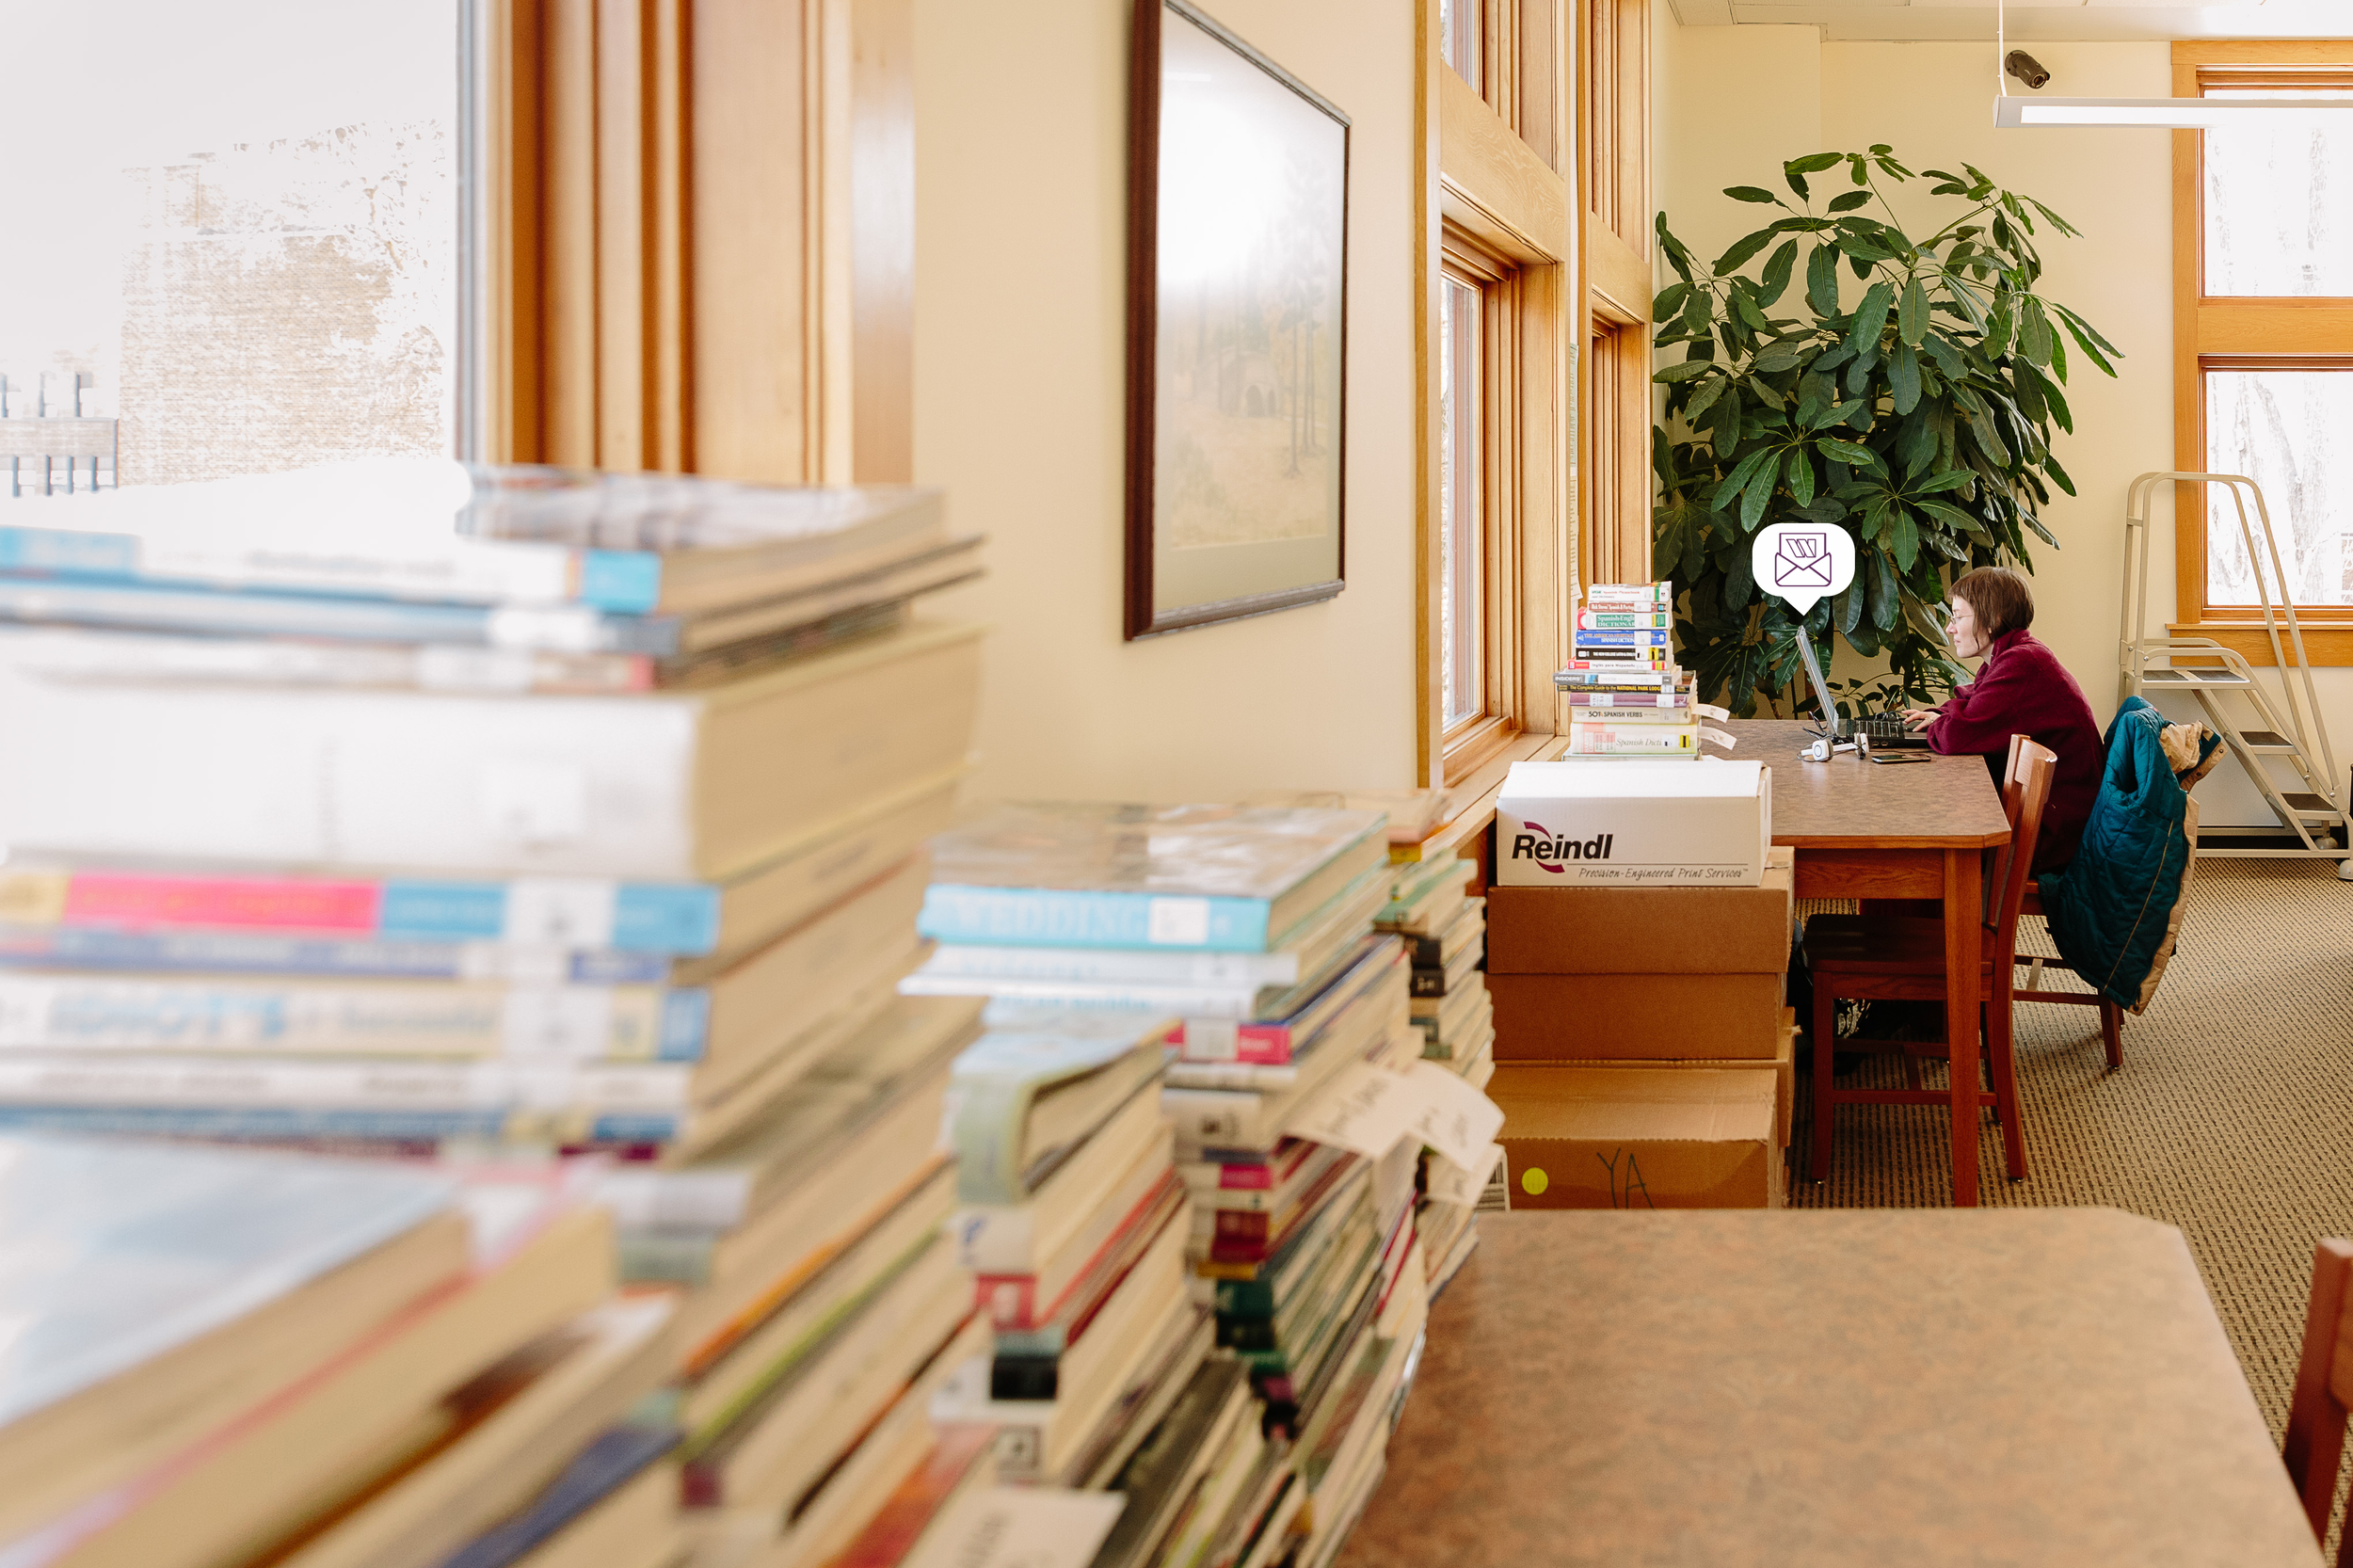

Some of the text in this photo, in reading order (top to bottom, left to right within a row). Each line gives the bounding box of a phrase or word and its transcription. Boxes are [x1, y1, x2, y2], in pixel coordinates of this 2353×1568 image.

[1616, 738, 1643, 746] Spanish
[1645, 738, 1662, 746] Dicti
[1512, 834, 1613, 859] Reindl
[1578, 868, 1675, 881] Precision-Engineered
[1677, 868, 1703, 878] Print
[1596, 1147, 1655, 1209] YA
